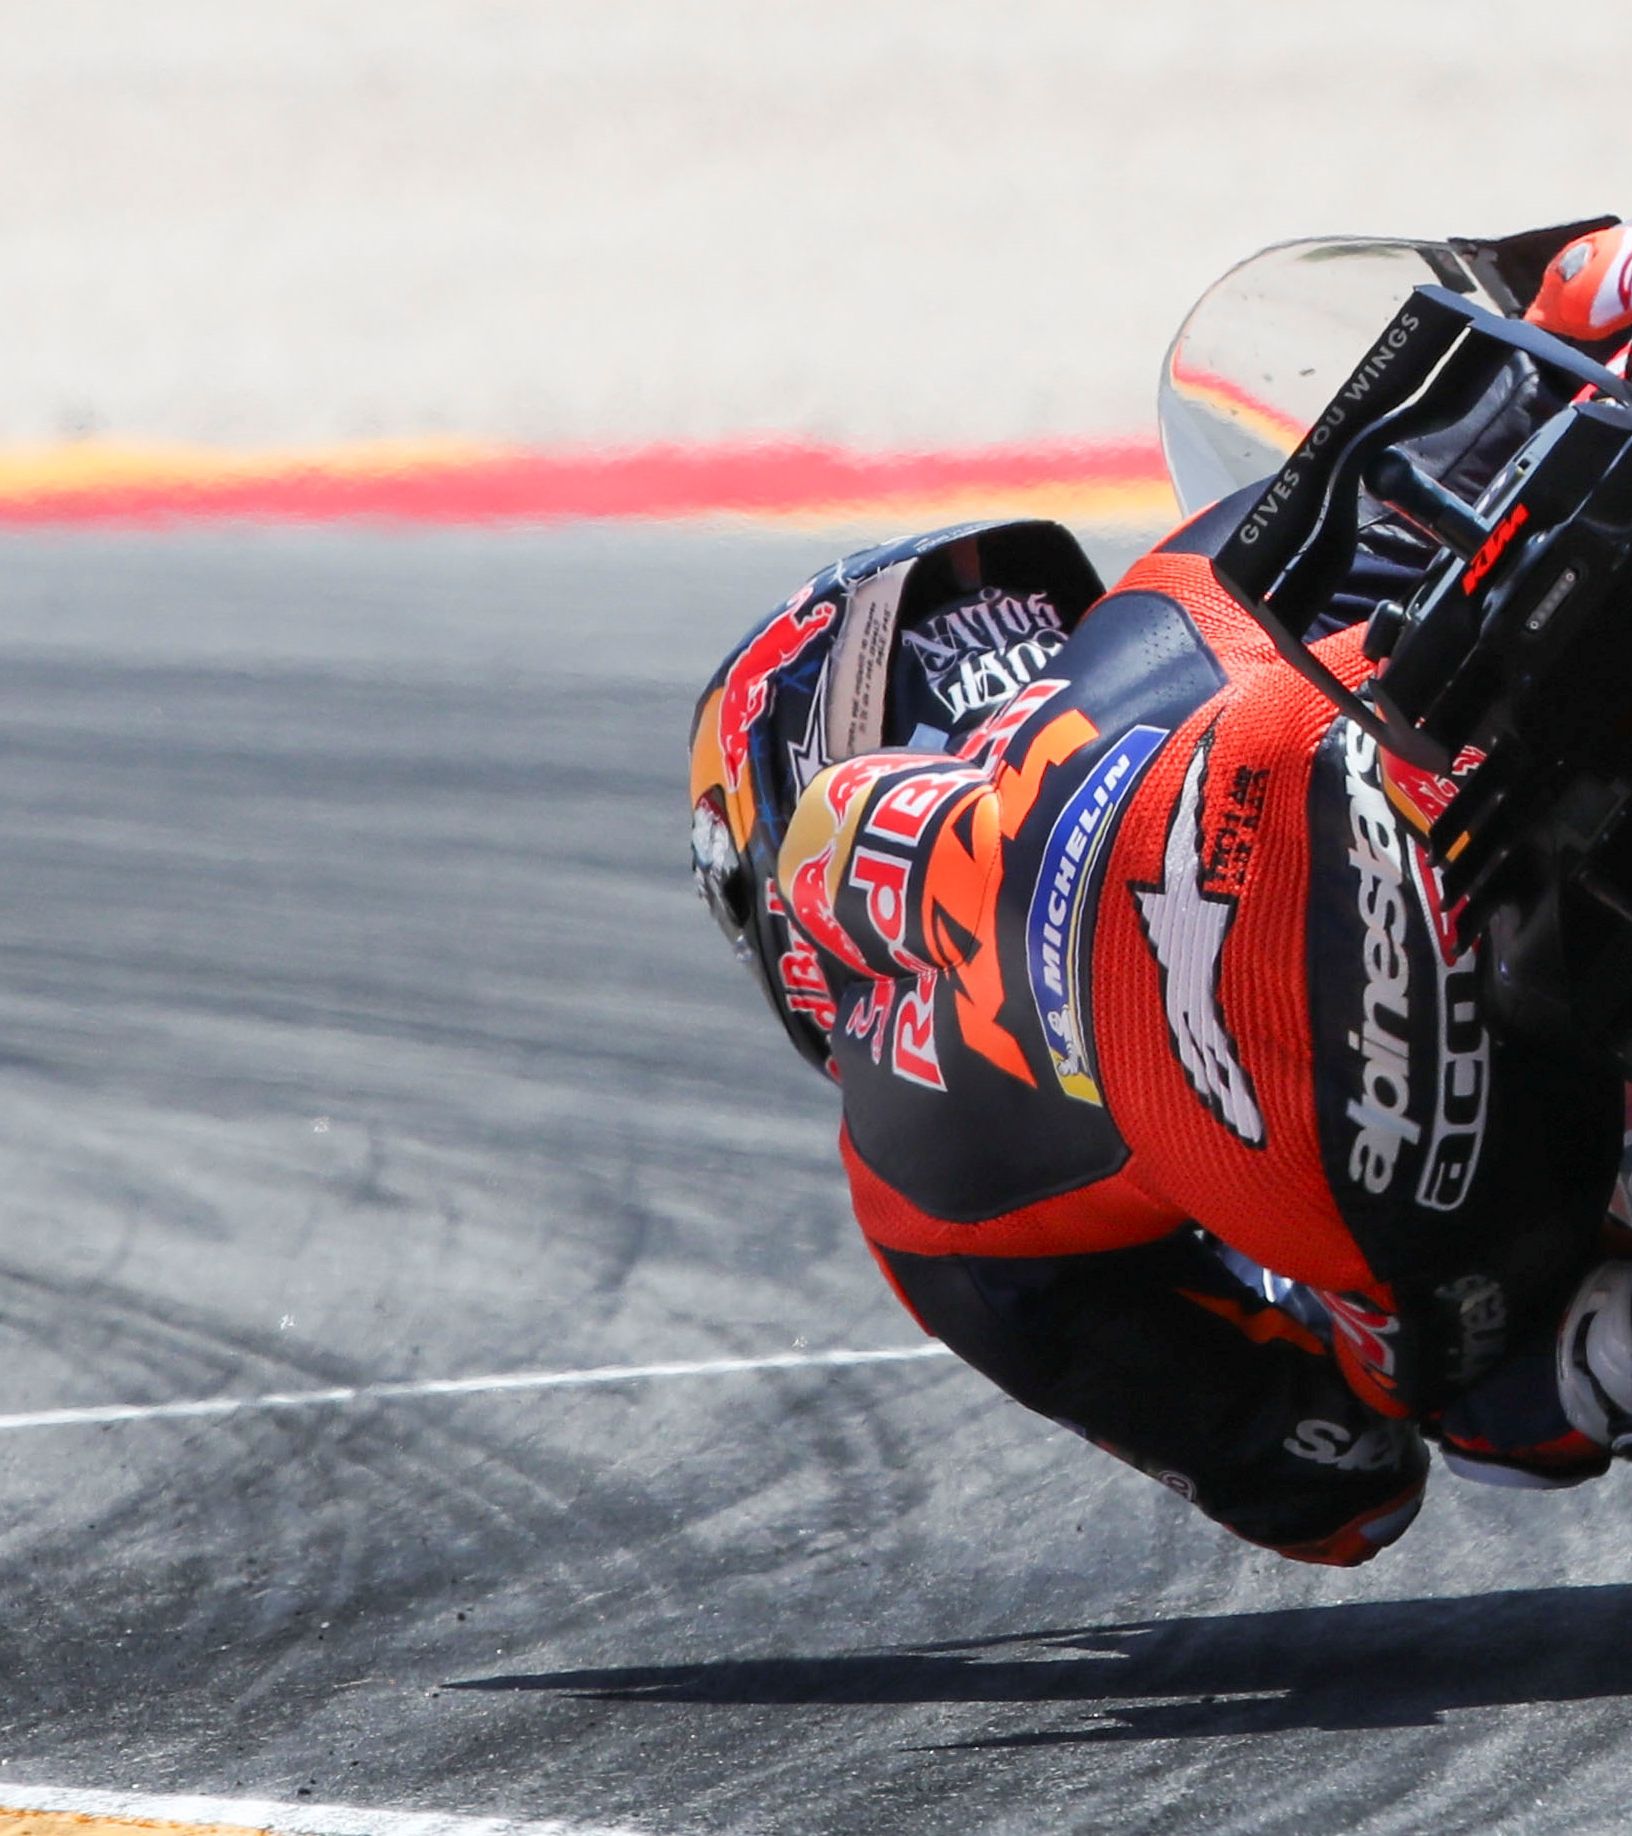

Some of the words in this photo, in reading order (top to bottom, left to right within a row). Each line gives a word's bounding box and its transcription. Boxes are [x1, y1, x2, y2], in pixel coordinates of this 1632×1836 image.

[1240, 468, 1300, 544] GIVES
[1300, 405, 1346, 461] YOU
[1344, 313, 1420, 400] WINGS
[1461, 503, 1530, 596] KTM
[1042, 753, 1132, 997] MICHELIN
[1345, 718, 1422, 1195] alpinestars
